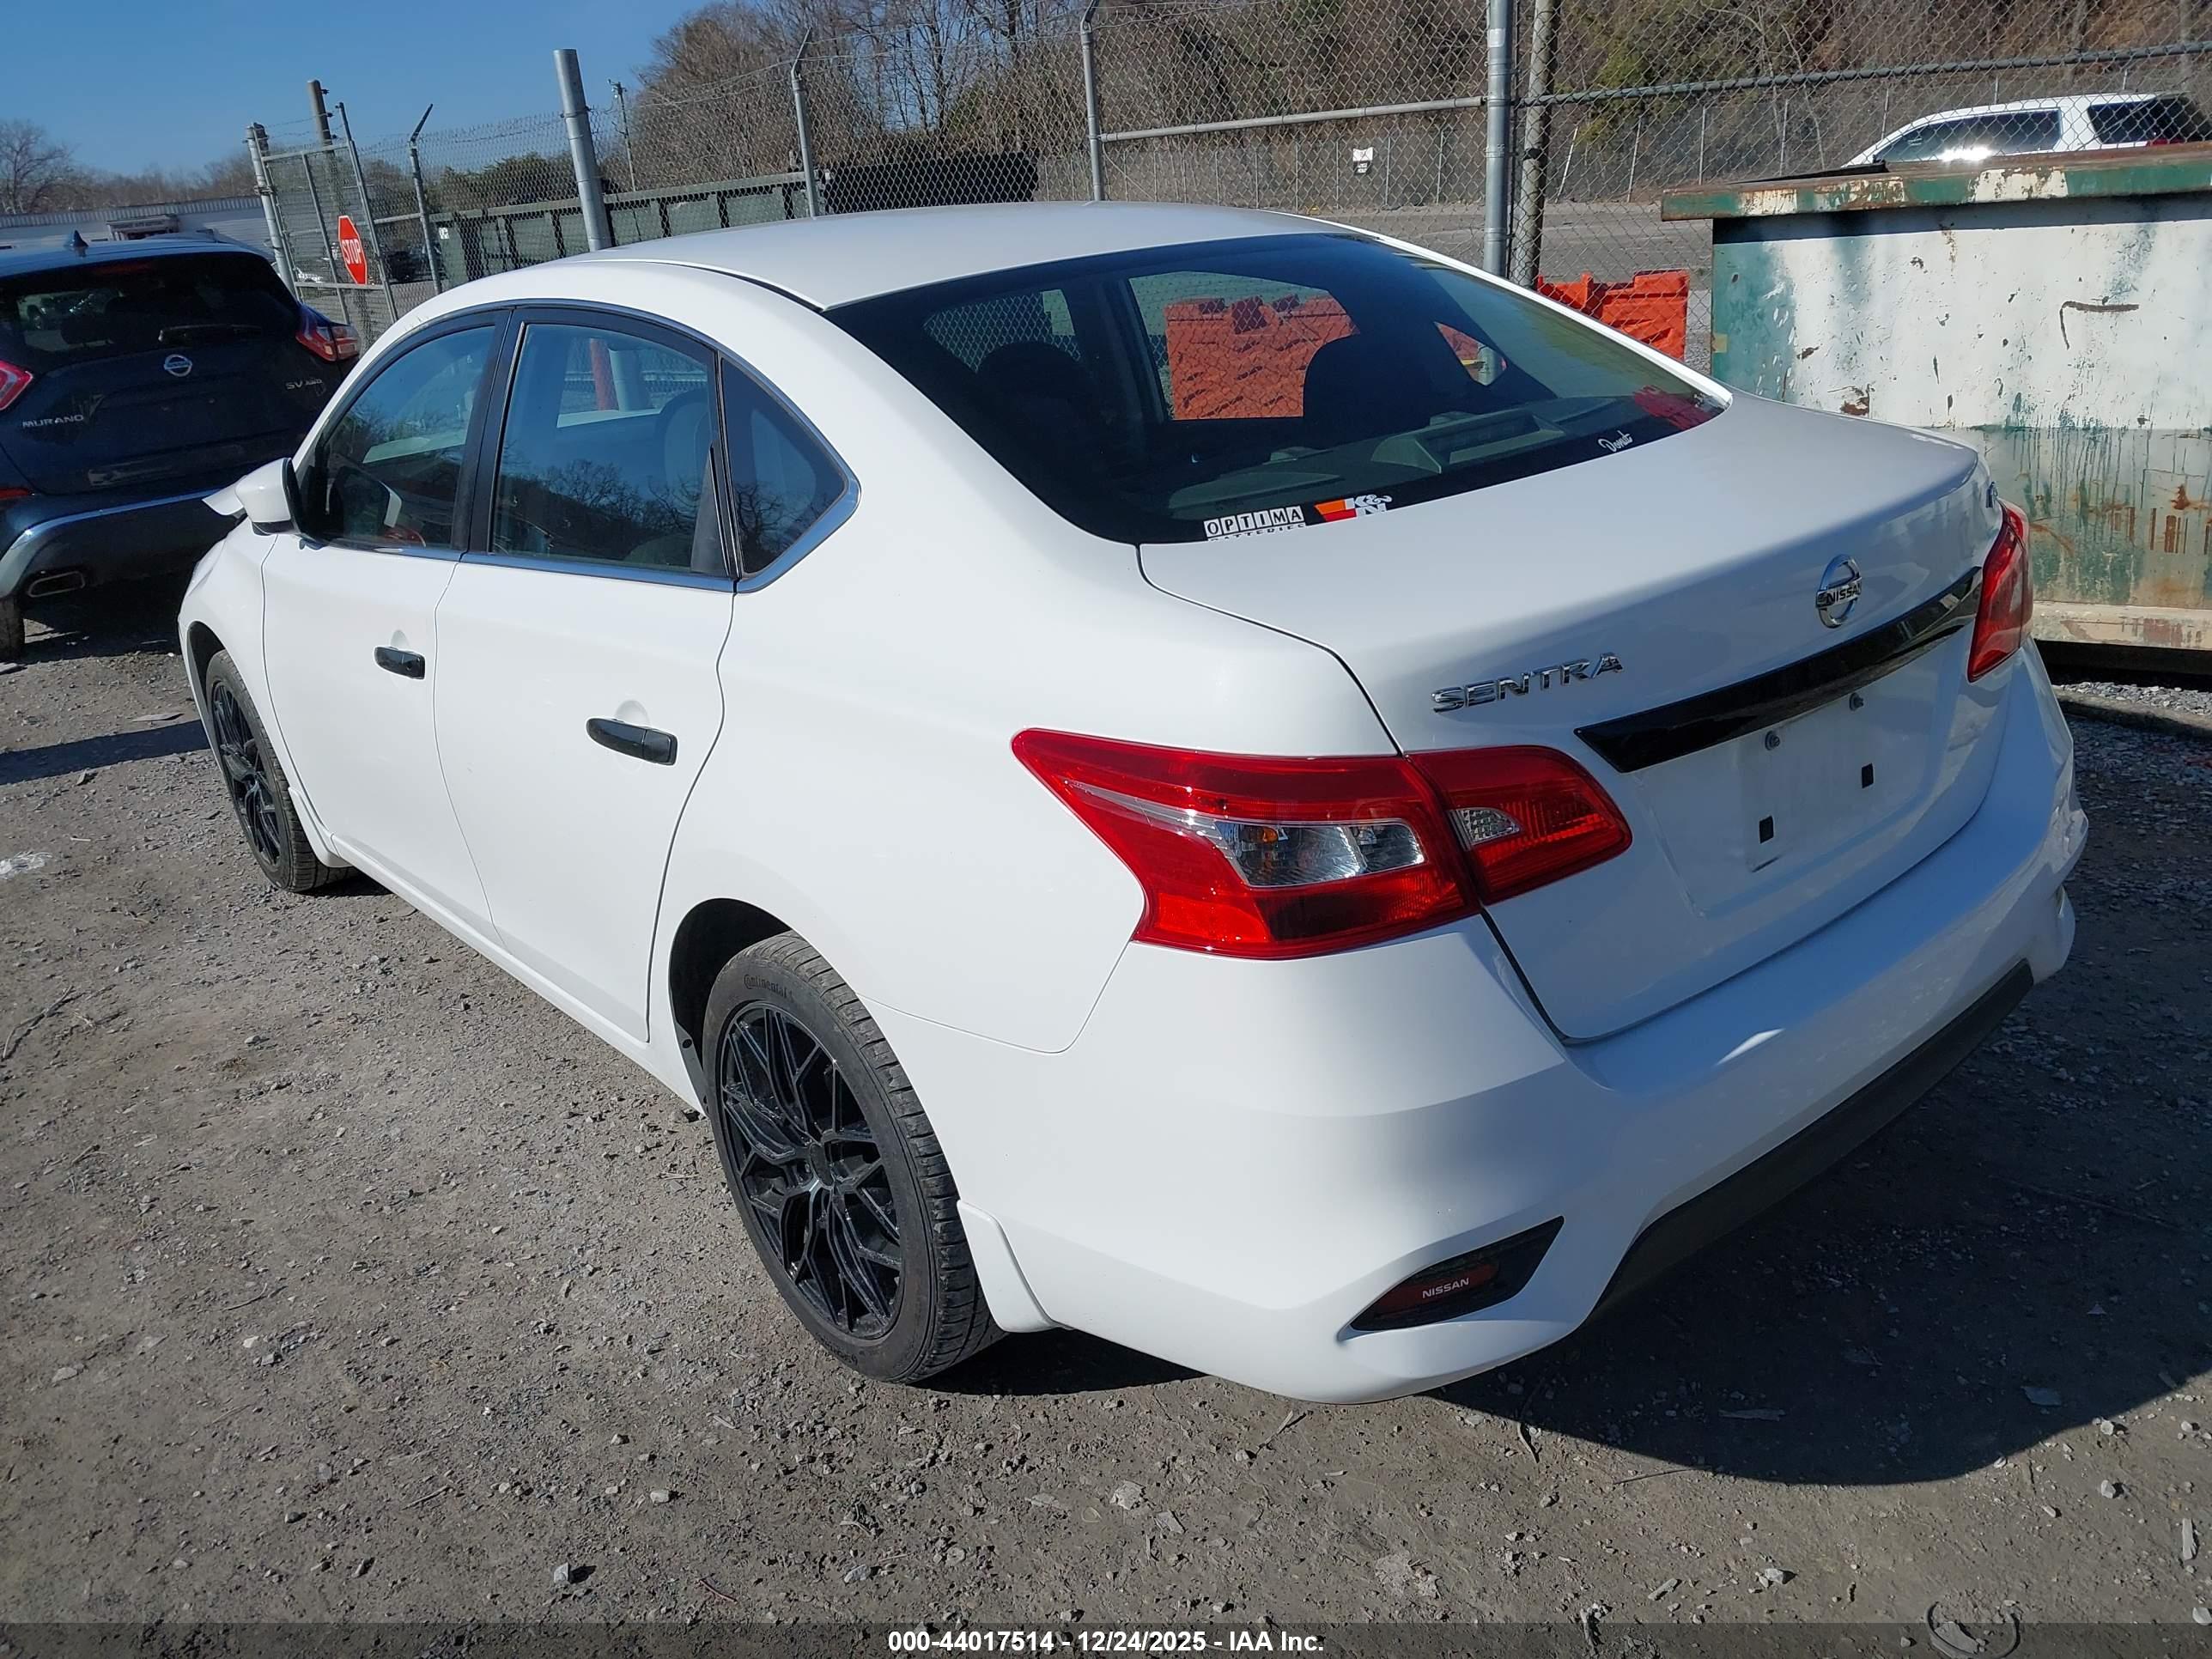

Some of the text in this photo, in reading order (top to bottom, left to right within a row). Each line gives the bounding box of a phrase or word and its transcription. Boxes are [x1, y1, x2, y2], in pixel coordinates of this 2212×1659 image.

[342, 239, 362, 264] STOP
[286, 380, 303, 390] SV
[22, 414, 84, 428] MURANO
[1206, 507, 1304, 536] OPTIMA
[1430, 652, 1624, 714] SENTRA
[1422, 1277, 1470, 1299] NISSAN
